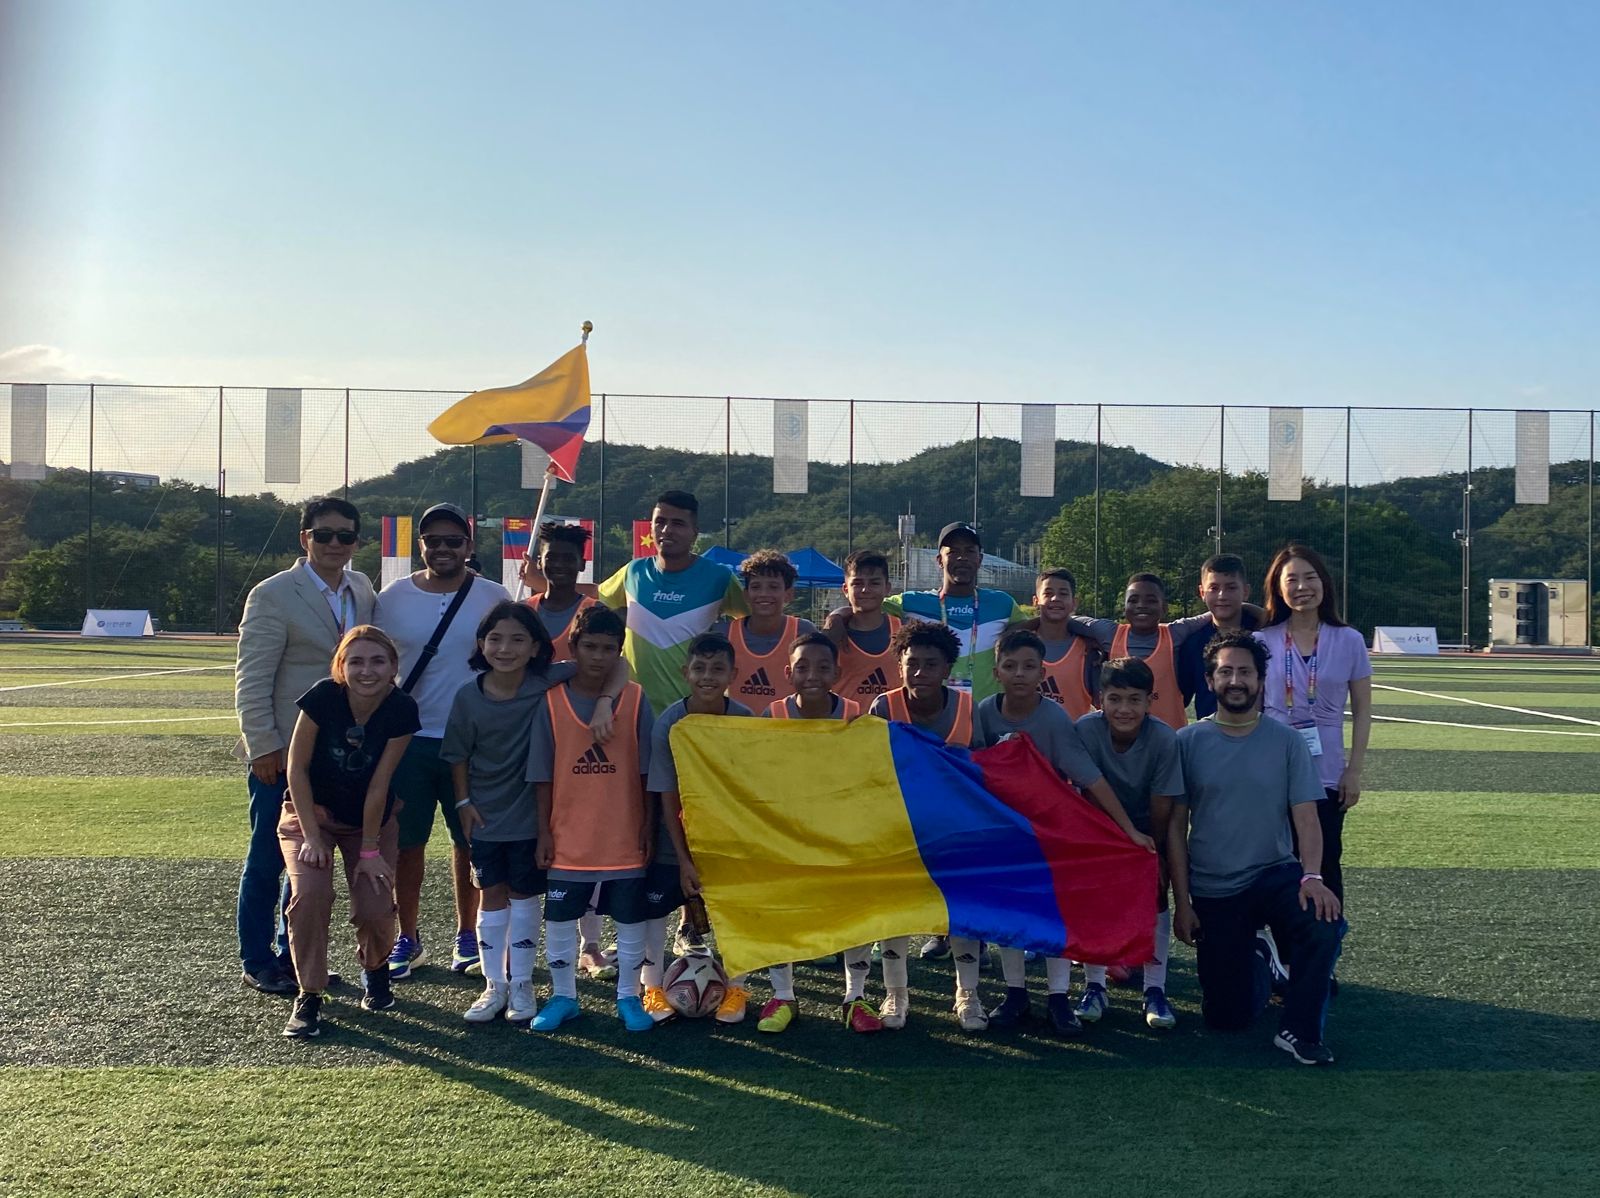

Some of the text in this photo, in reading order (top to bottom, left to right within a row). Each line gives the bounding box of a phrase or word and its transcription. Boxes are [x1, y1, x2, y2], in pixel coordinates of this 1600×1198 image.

[740, 684, 776, 697] adidas
[857, 684, 889, 695] adida
[572, 762, 617, 775] adidas
